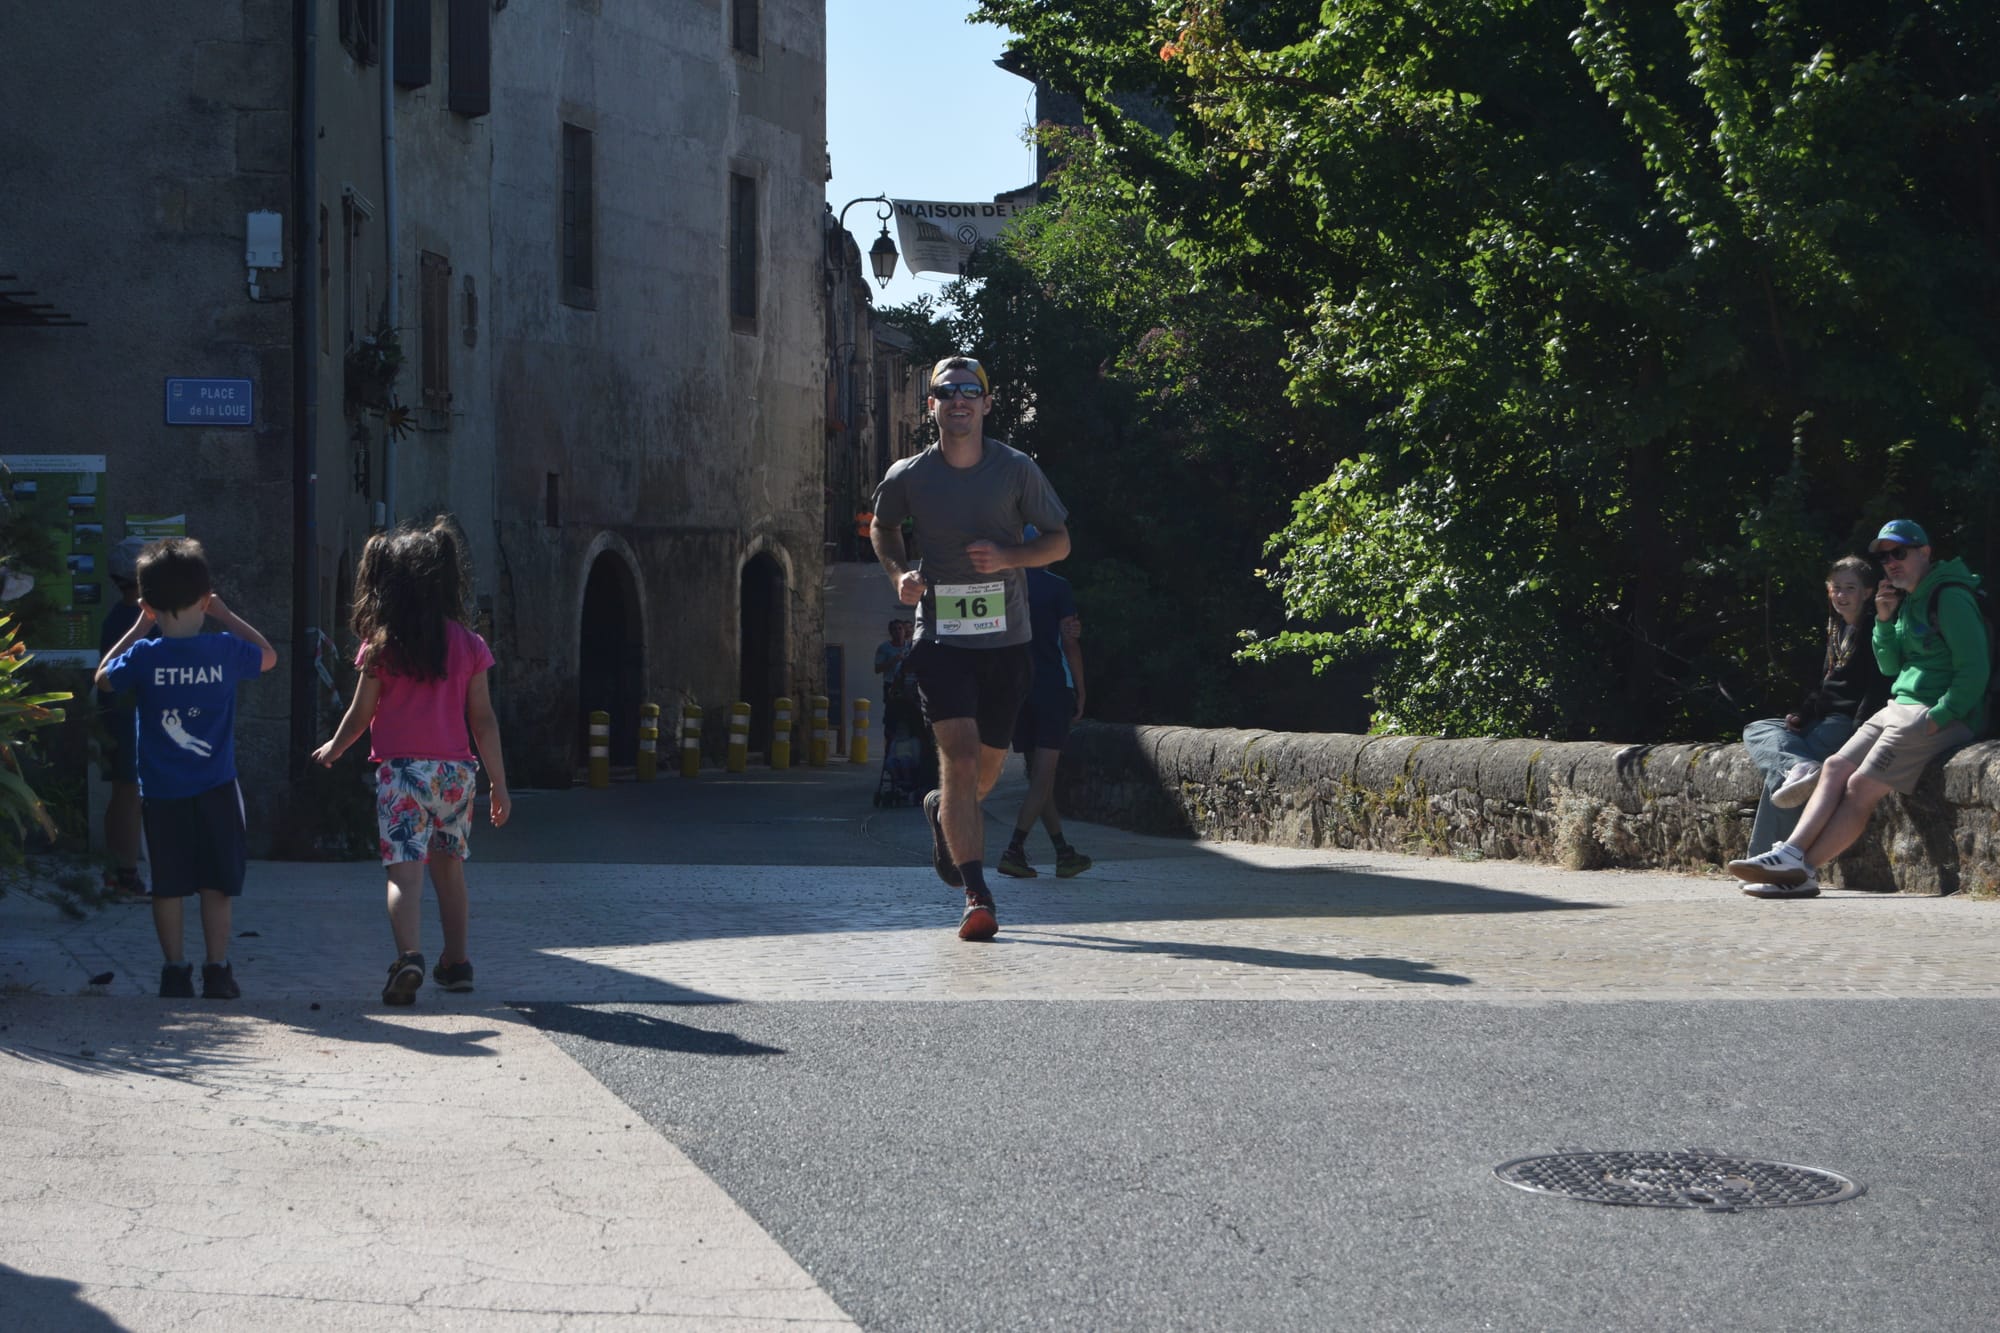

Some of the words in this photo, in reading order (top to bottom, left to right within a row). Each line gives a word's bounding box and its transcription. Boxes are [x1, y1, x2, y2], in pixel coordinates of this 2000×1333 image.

[898, 204, 977, 218] MAISON
[982, 205, 1006, 217] DE
[200, 387, 235, 399] PLACE
[190, 404, 202, 416] de
[205, 404, 215, 416] la
[218, 404, 247, 416] LOUE
[955, 597, 988, 618] 16
[154, 664, 223, 685] ETHAN
